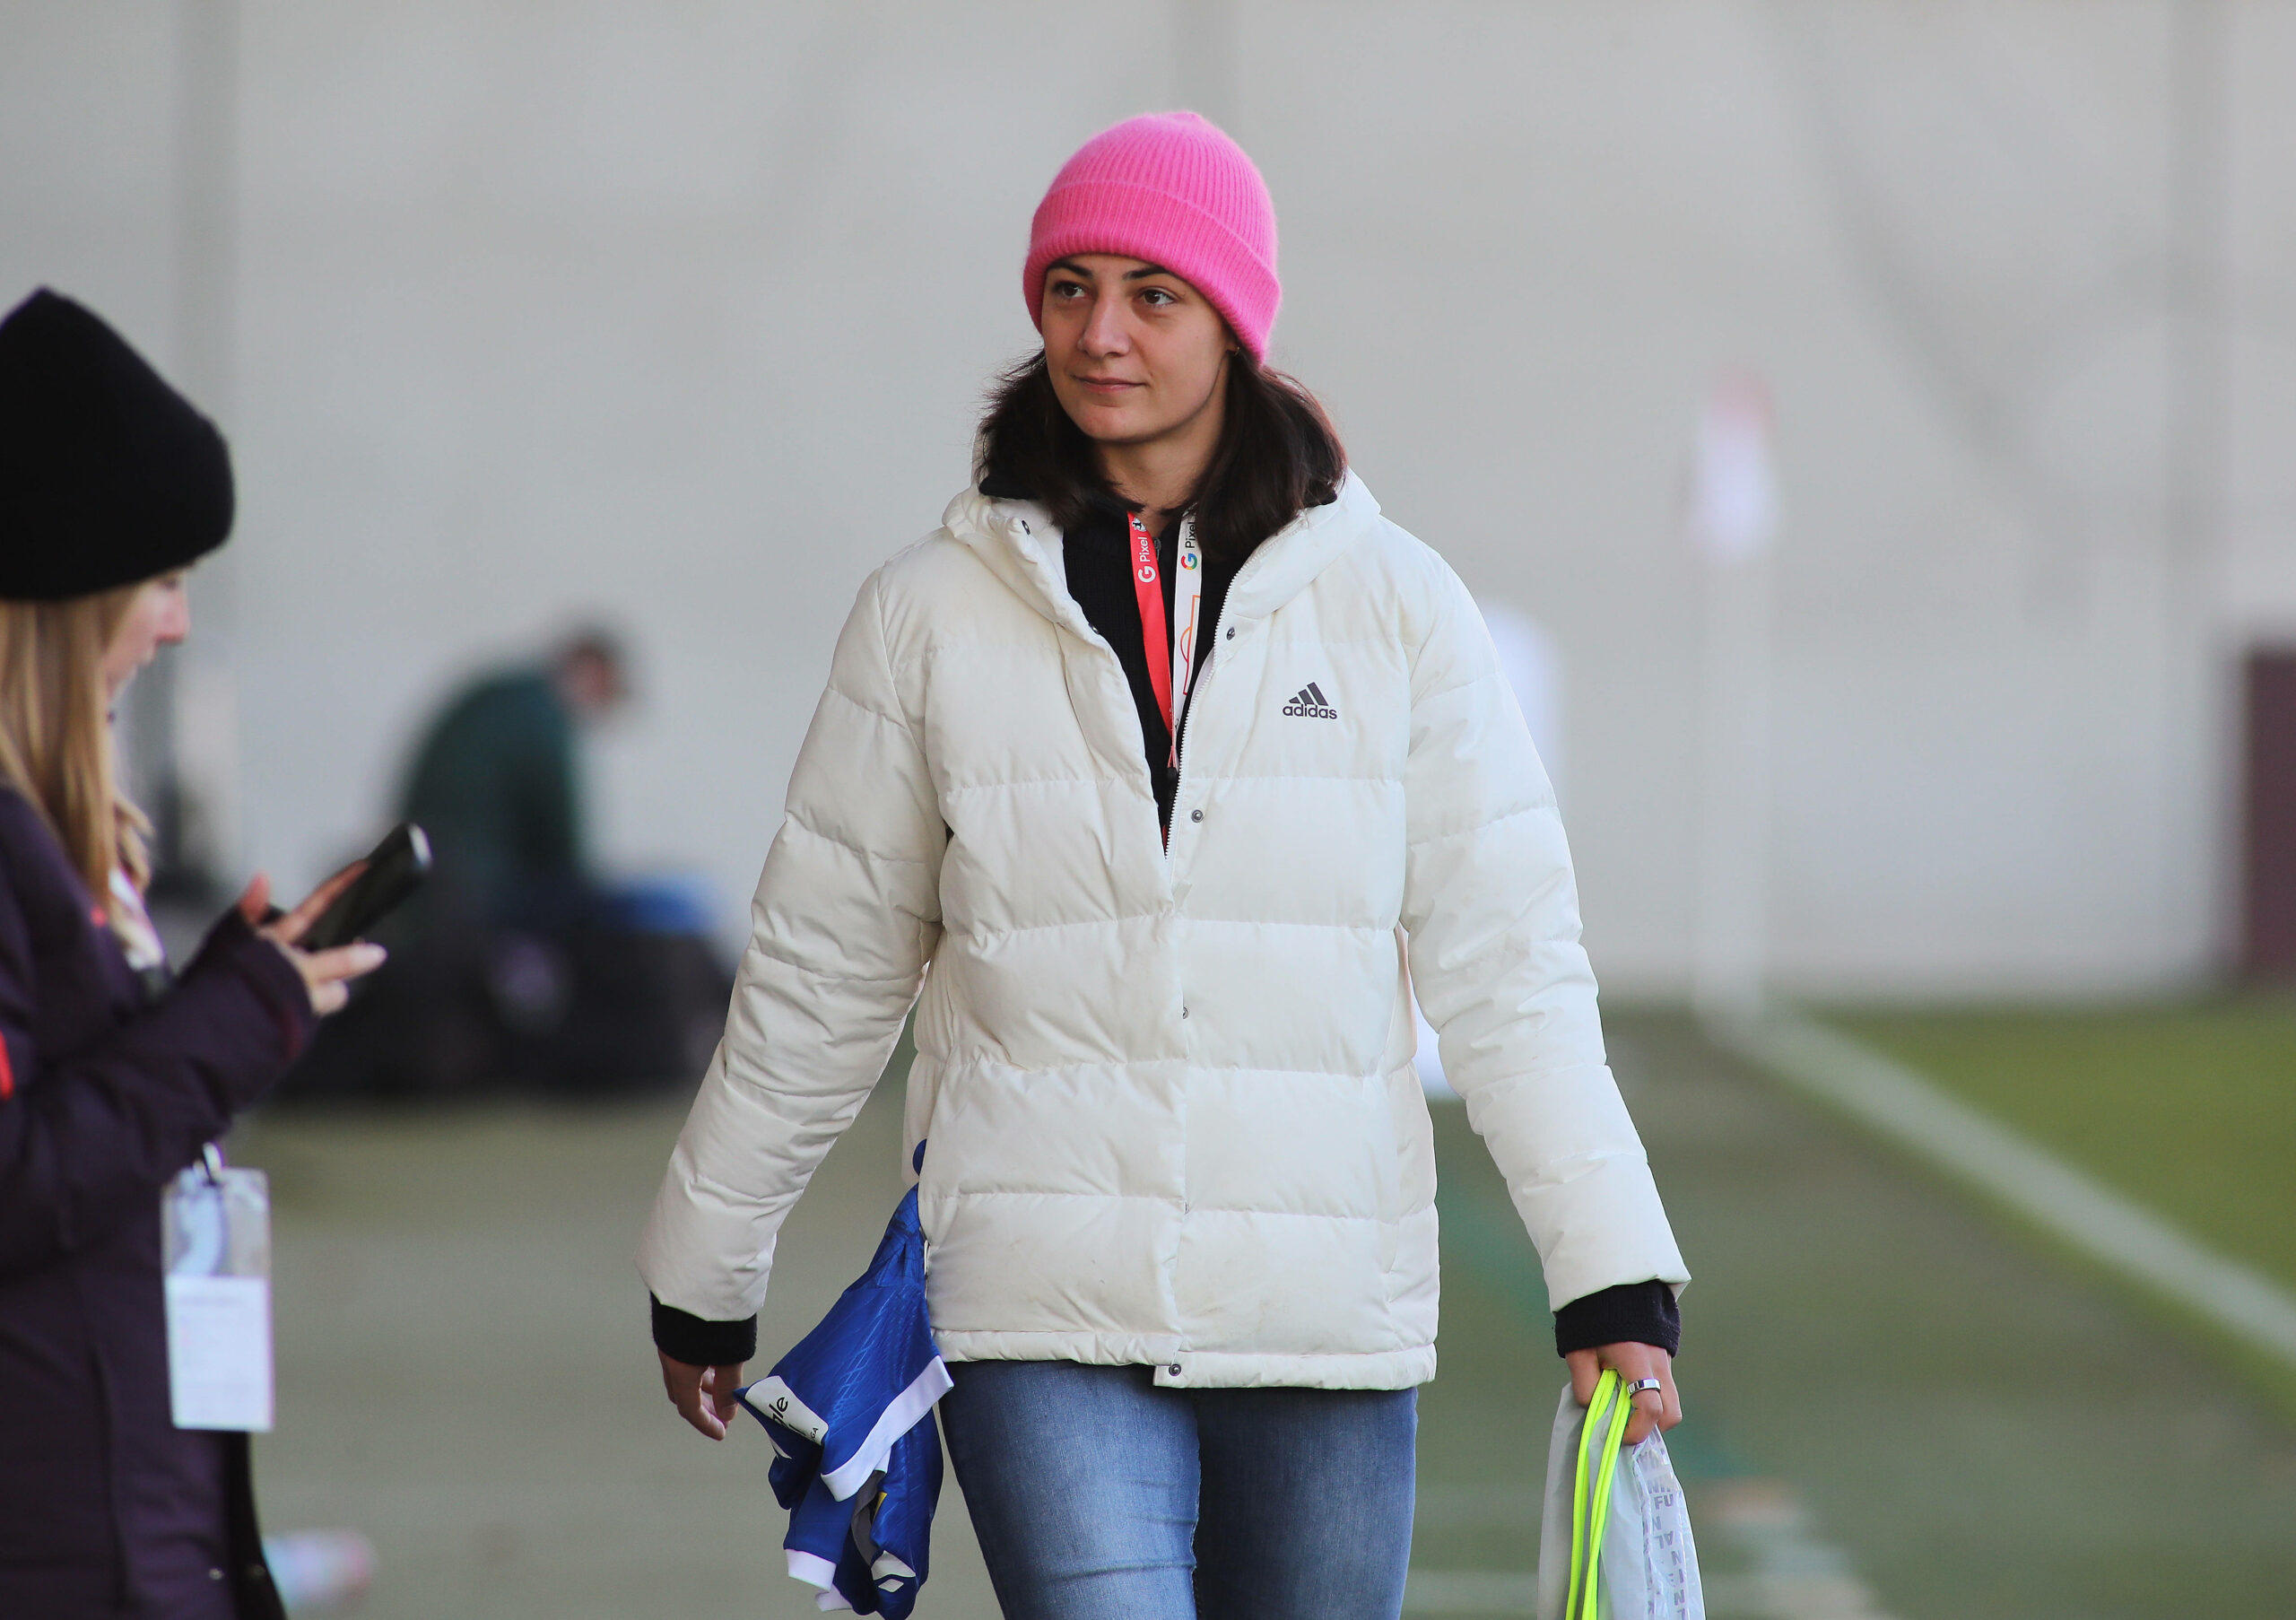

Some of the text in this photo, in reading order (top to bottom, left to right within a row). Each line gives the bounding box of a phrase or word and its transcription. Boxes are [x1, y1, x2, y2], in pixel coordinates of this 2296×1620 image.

[1185, 521, 1197, 549] Pixel
[1137, 536, 1152, 562] Pixel
[1282, 703, 1338, 719] adidas
